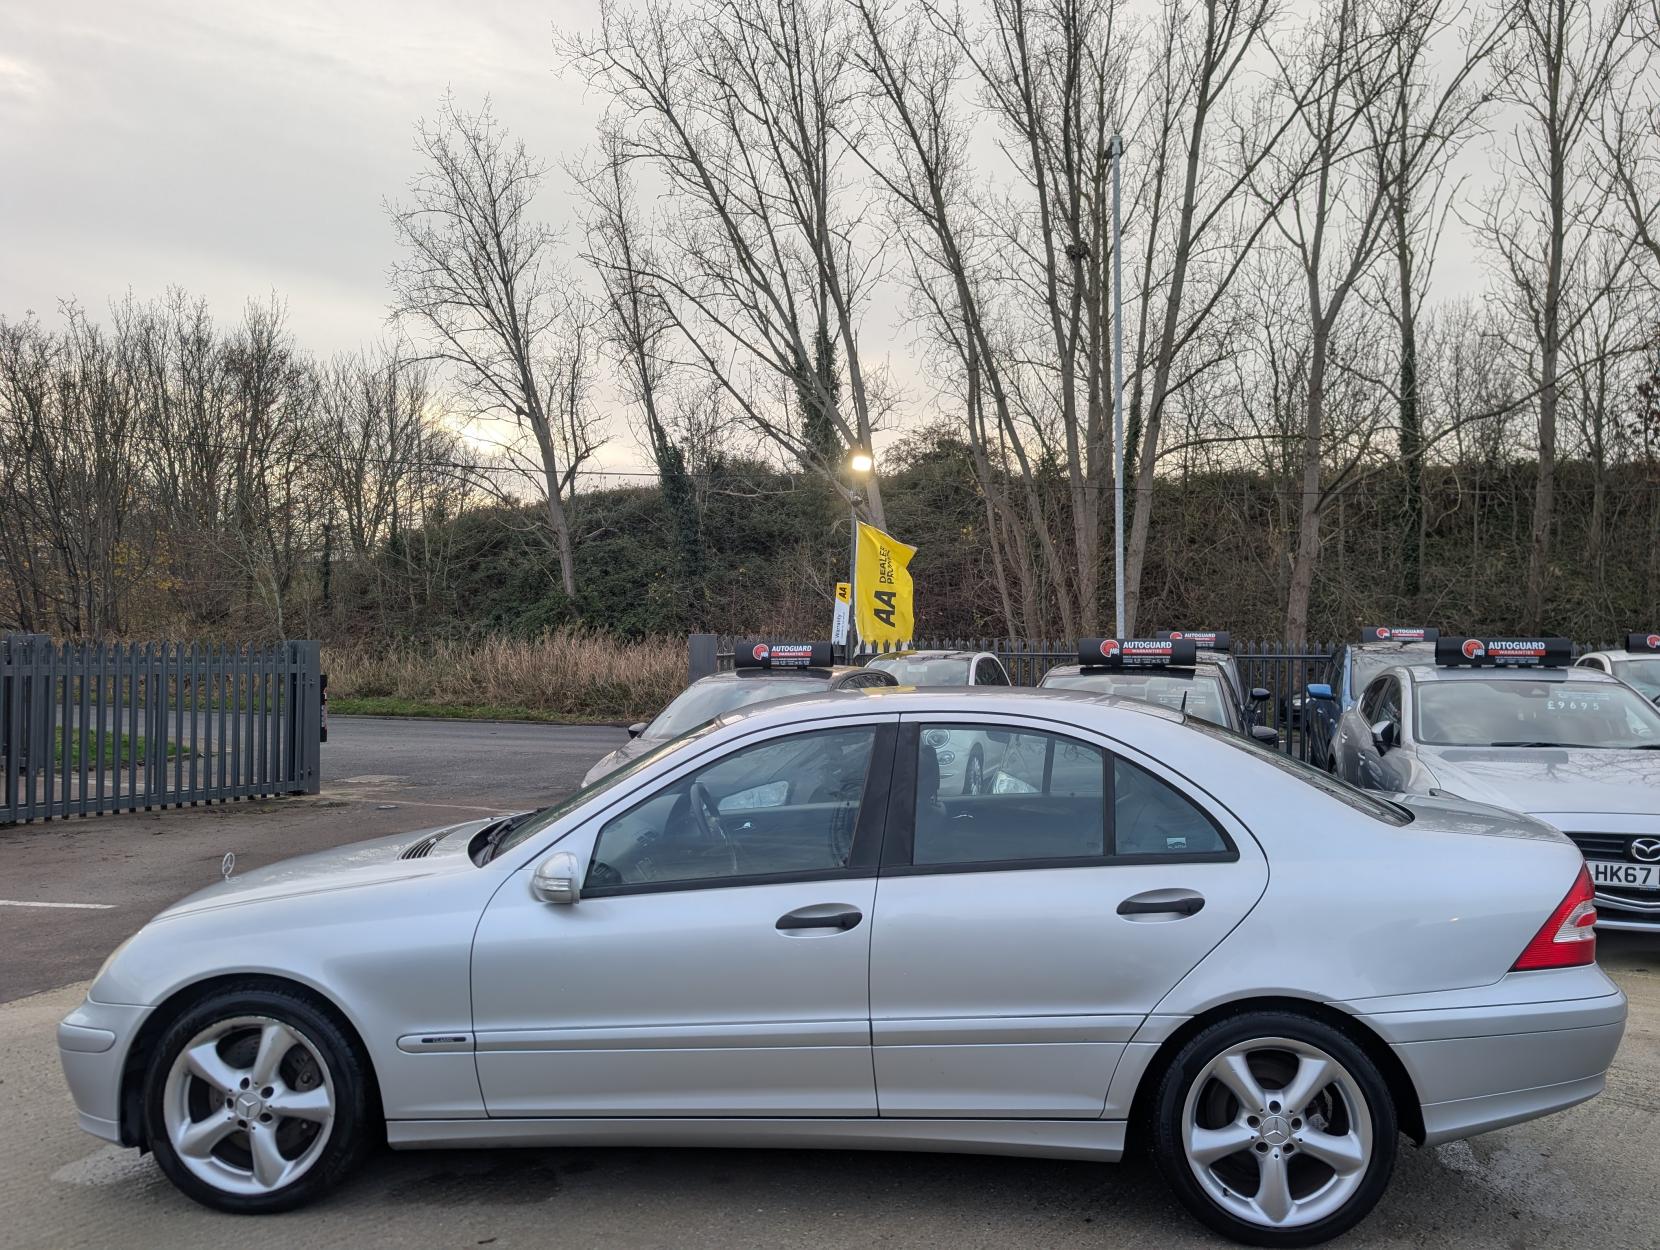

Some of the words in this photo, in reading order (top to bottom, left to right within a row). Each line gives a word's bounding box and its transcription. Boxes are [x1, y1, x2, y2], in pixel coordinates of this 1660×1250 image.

[838, 587, 847, 599] AA
[873, 590, 897, 629] AA
[1122, 641, 1173, 649] AUTOGUARD
[1487, 641, 1546, 650] AUTOGUARD
[1547, 701, 1600, 711] £9695
[1595, 863, 1652, 885] HK67
